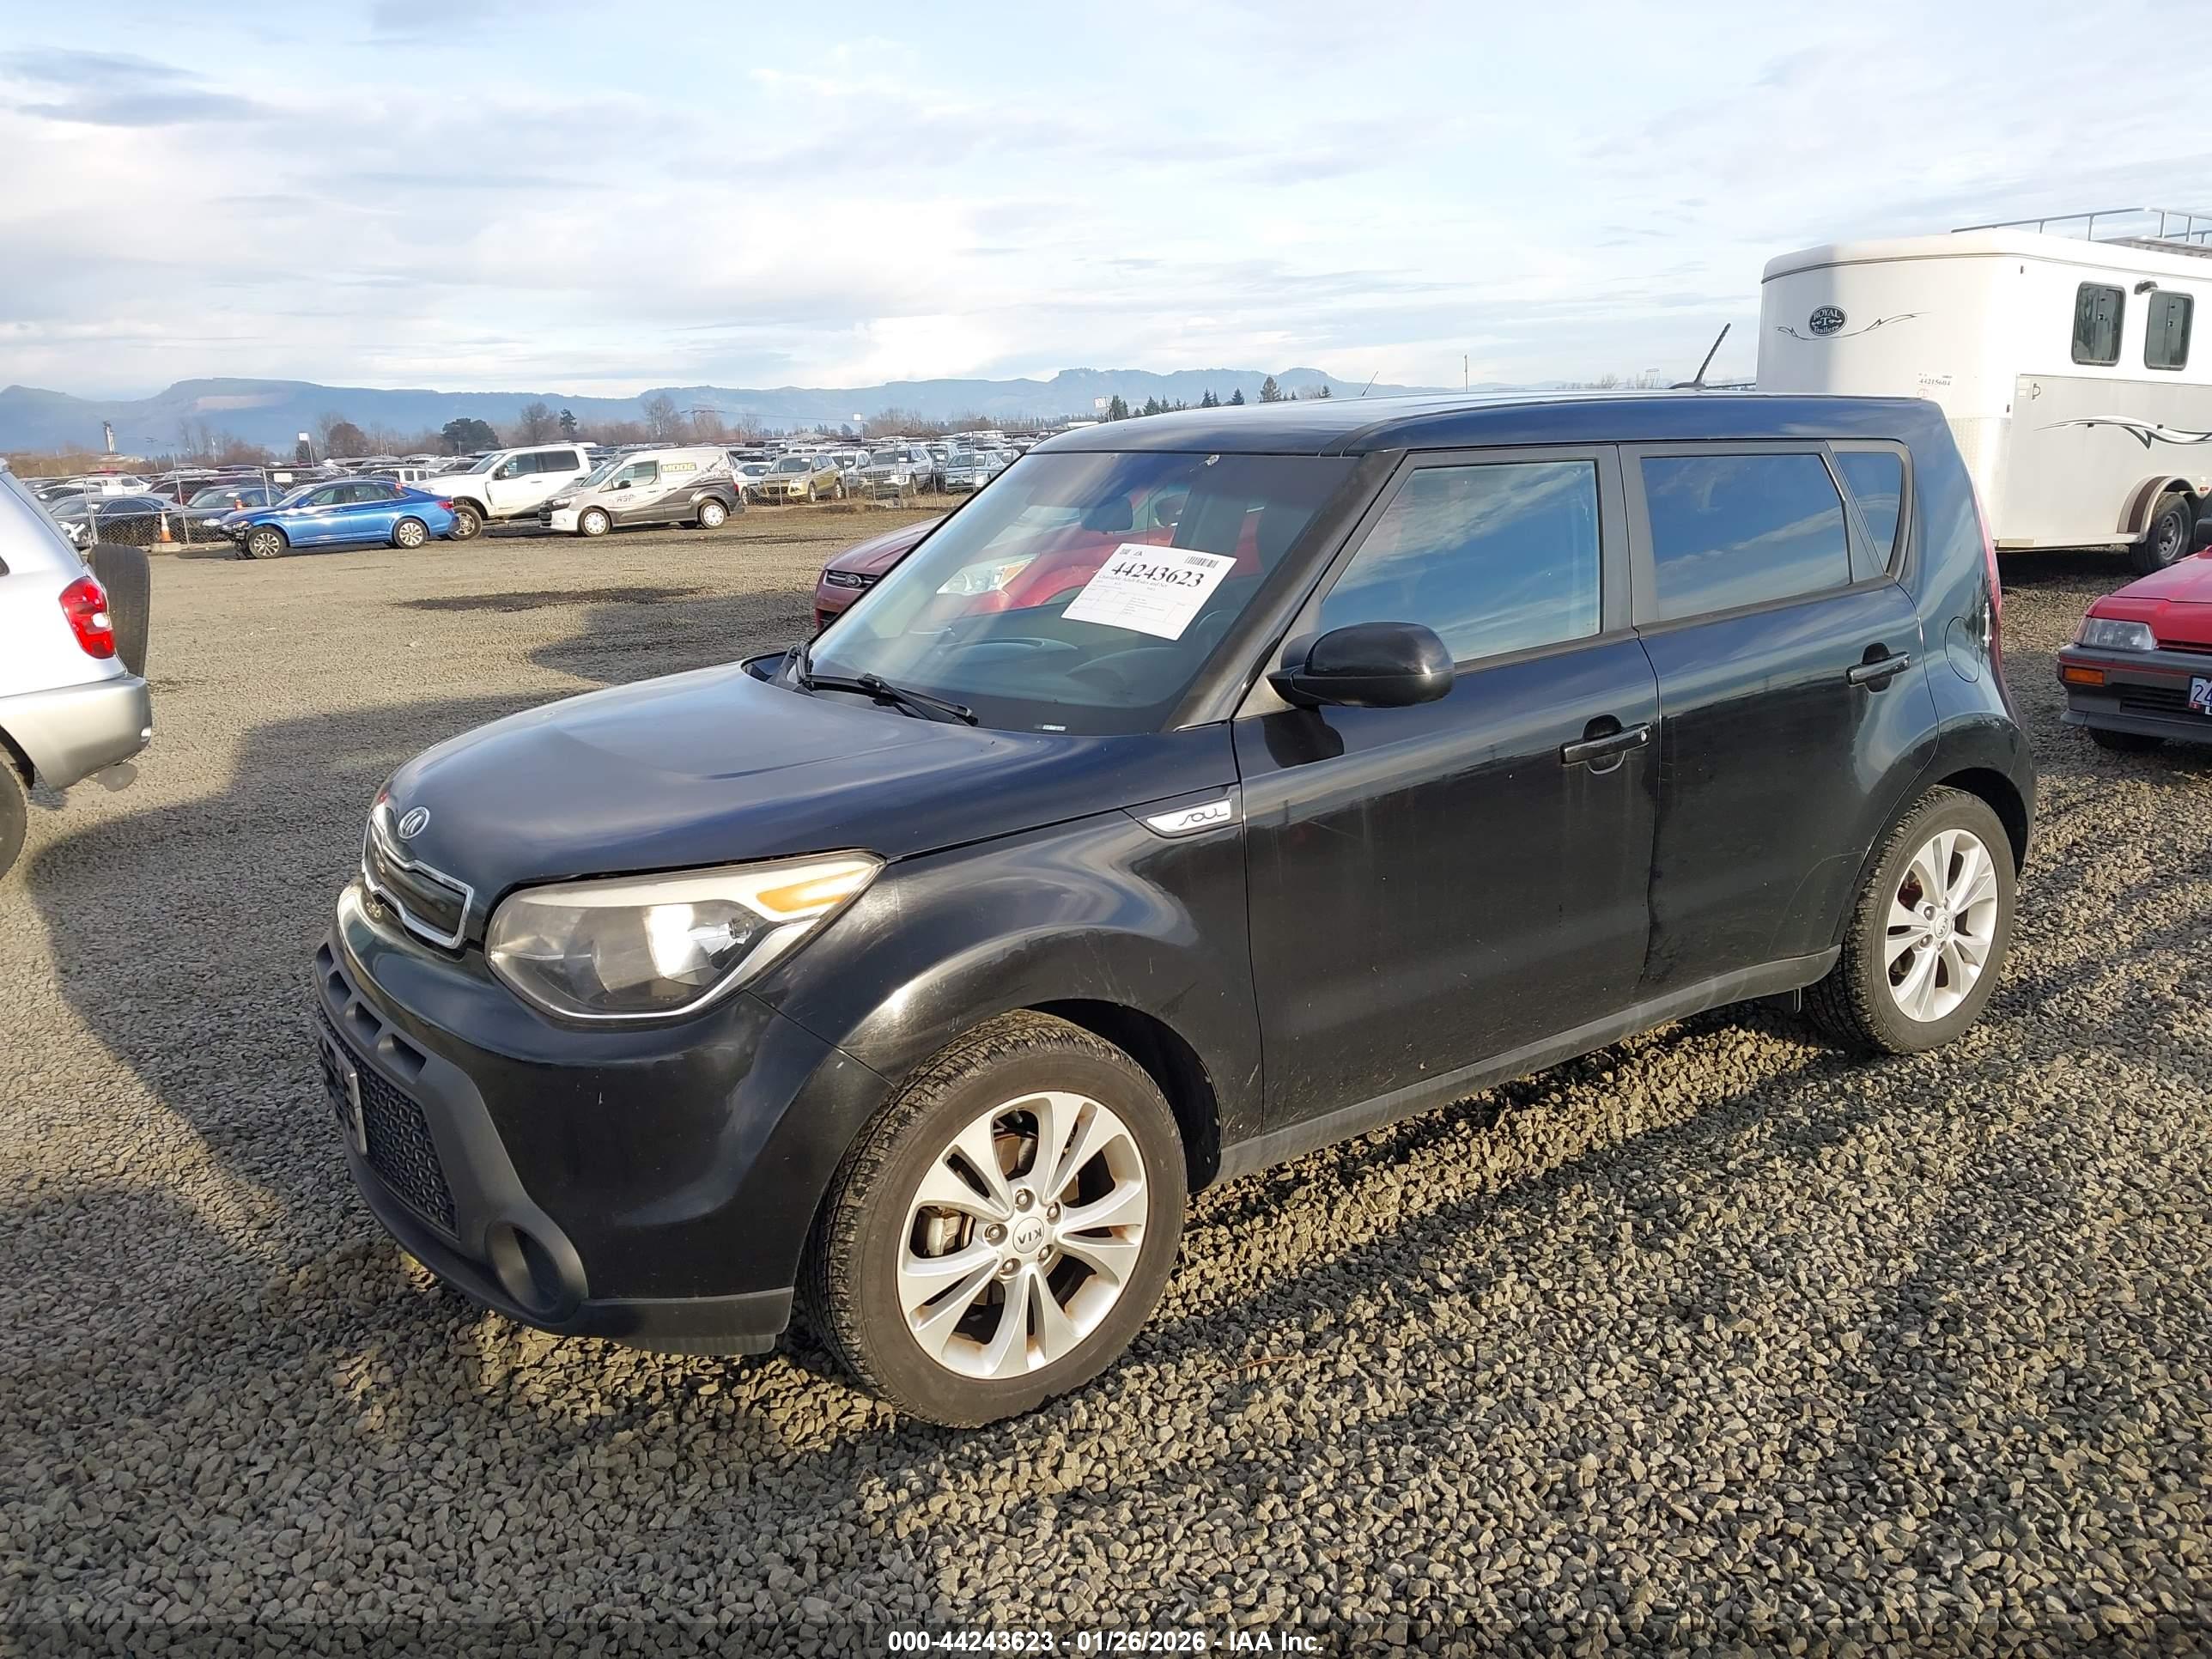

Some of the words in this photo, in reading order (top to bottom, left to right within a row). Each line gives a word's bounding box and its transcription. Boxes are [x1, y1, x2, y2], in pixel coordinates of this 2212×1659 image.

[1814, 308, 1840, 321] ROYAL
[662, 463, 695, 472] MOOG
[1111, 561, 1206, 588] 44243623
[1017, 1227, 1042, 1245] KIA
